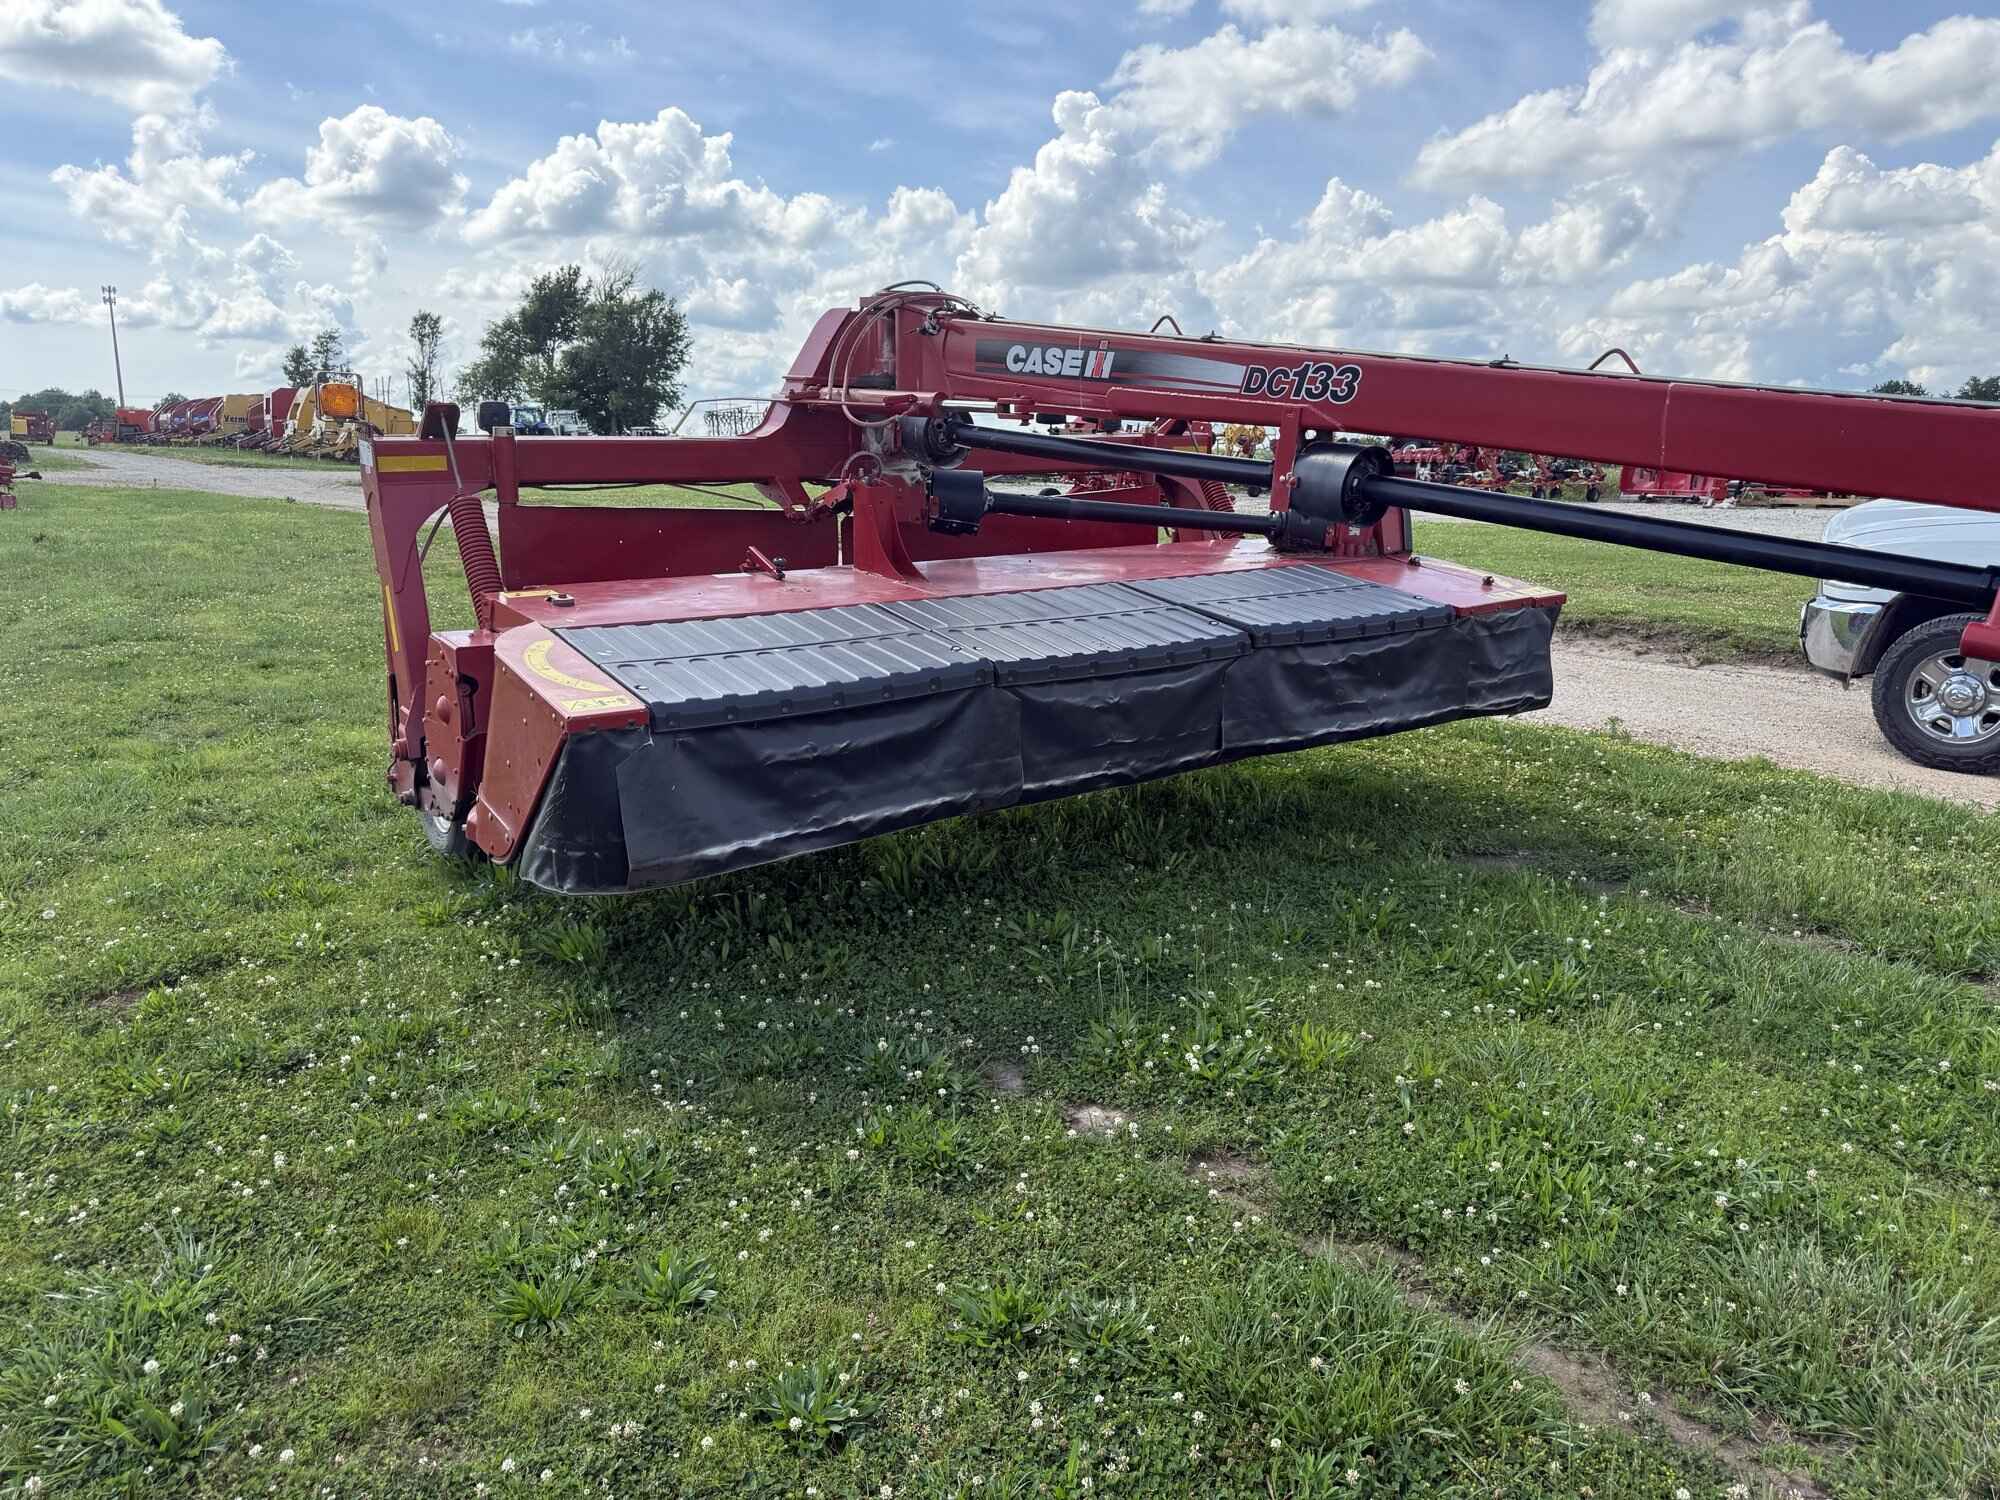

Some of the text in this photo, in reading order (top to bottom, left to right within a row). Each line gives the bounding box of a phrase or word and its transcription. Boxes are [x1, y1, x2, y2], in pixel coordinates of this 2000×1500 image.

[1006, 344, 1084, 376] CASE
[1241, 362, 1362, 404] DC133
[224, 415, 247, 423] Verm
